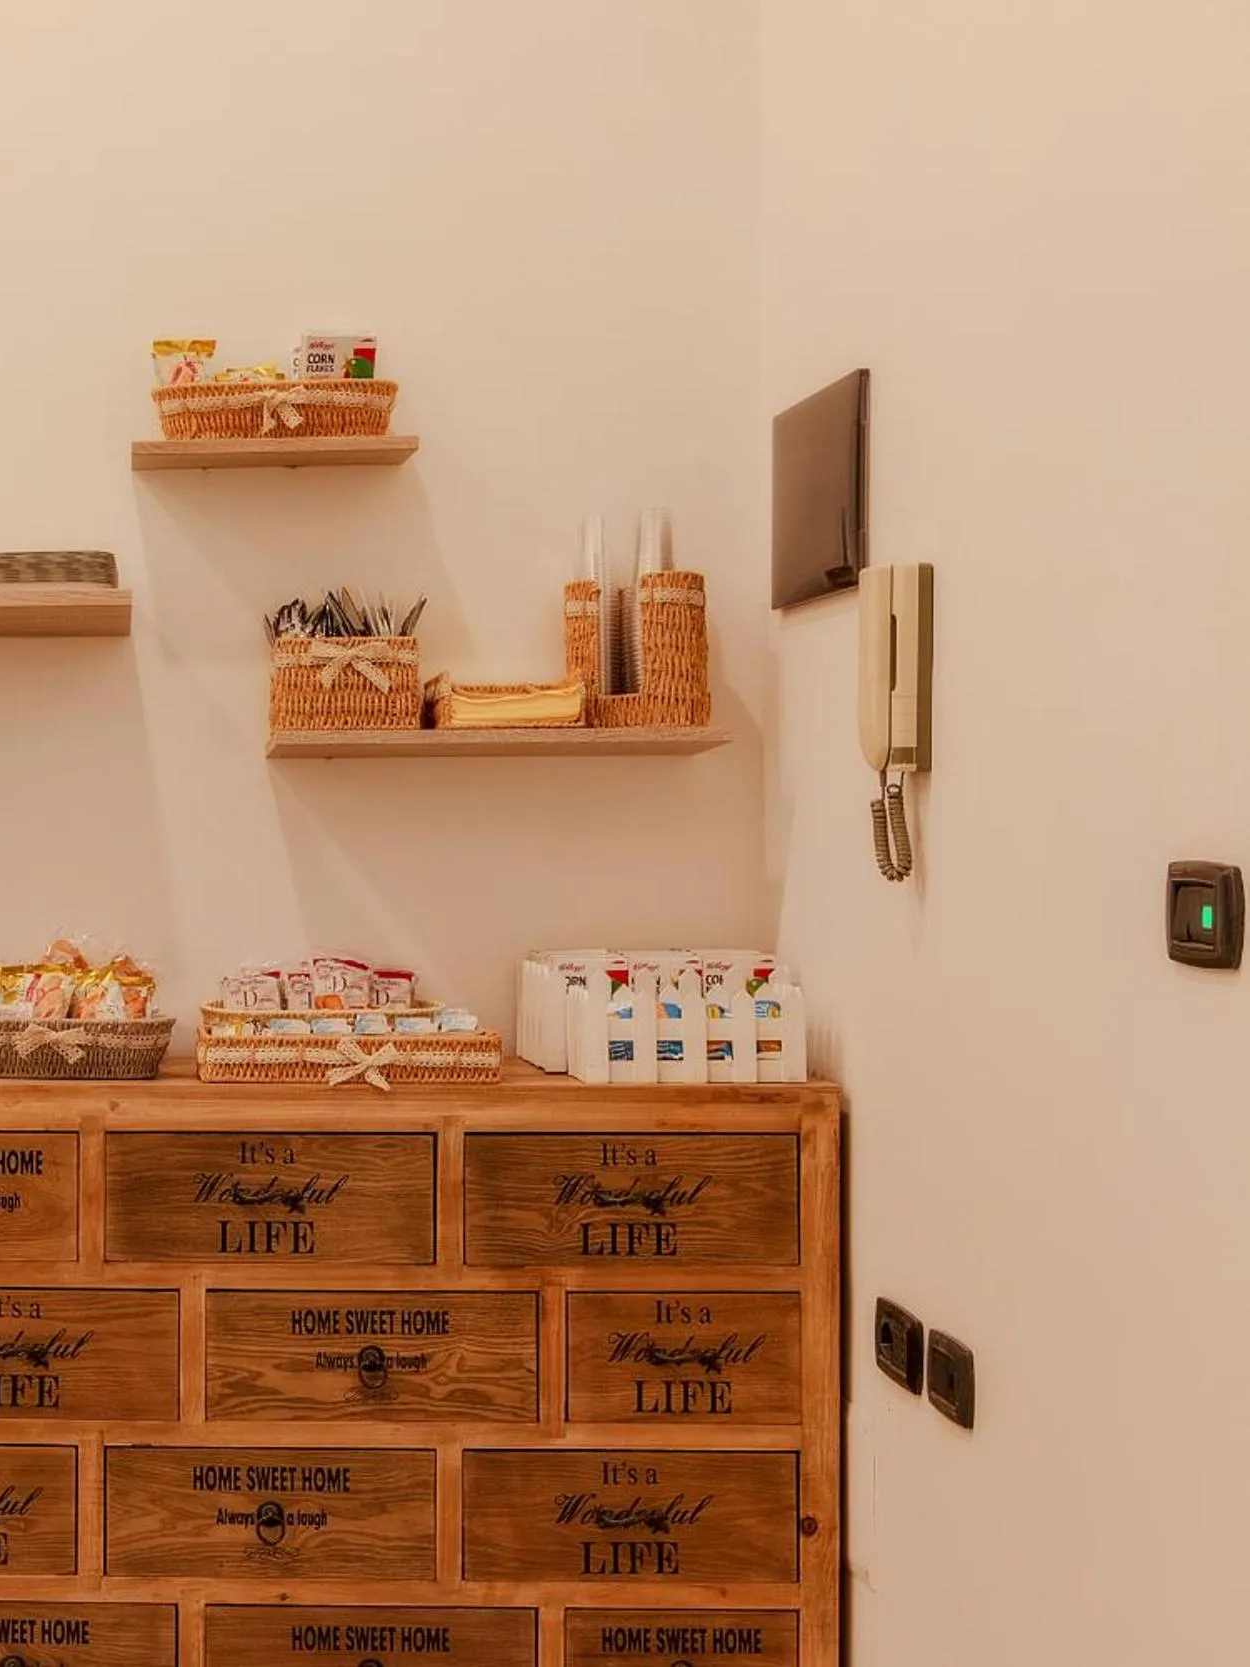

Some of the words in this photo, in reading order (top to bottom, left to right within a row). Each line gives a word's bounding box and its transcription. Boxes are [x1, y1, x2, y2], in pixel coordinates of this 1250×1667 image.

[306, 364, 335, 373] FLAKES
[307, 353, 336, 364] CORN
[239, 1141, 276, 1165] It's
[282, 1148, 296, 1165] a
[601, 1143, 638, 1167] It's
[644, 1150, 658, 1167] a
[192, 1172, 349, 1207] Wodful
[553, 1174, 713, 1209] Wodful
[217, 1220, 316, 1255] LIFE
[580, 1222, 678, 1257] LIFE
[30, 1303, 43, 1319] a
[291, 1310, 340, 1336] HOME
[345, 1310, 397, 1336] SWEET
[401, 1310, 450, 1336] HOME
[655, 1300, 693, 1325] It's
[699, 1307, 712, 1325] a
[315, 1350, 354, 1372] Always
[396, 1350, 429, 1372] laugh
[607, 1331, 767, 1368] Wodful
[632, 1380, 732, 1414] LIFE
[192, 1466, 241, 1492] HOME
[246, 1466, 297, 1492] SWEET
[301, 1466, 350, 1492] HOME
[602, 1461, 639, 1486] It's
[645, 1468, 659, 1486] a
[216, 1507, 255, 1528] Always
[297, 1508, 327, 1529] laugh
[554, 1493, 714, 1528] Wodful
[581, 1541, 680, 1575] LIFE
[42, 1619, 90, 1644] HOME
[291, 1626, 340, 1652] HOME
[345, 1626, 397, 1652] SWEET
[401, 1626, 450, 1652] HOME
[602, 1628, 651, 1654] HOME
[656, 1628, 707, 1654] SWEET
[712, 1628, 762, 1654] HOME
